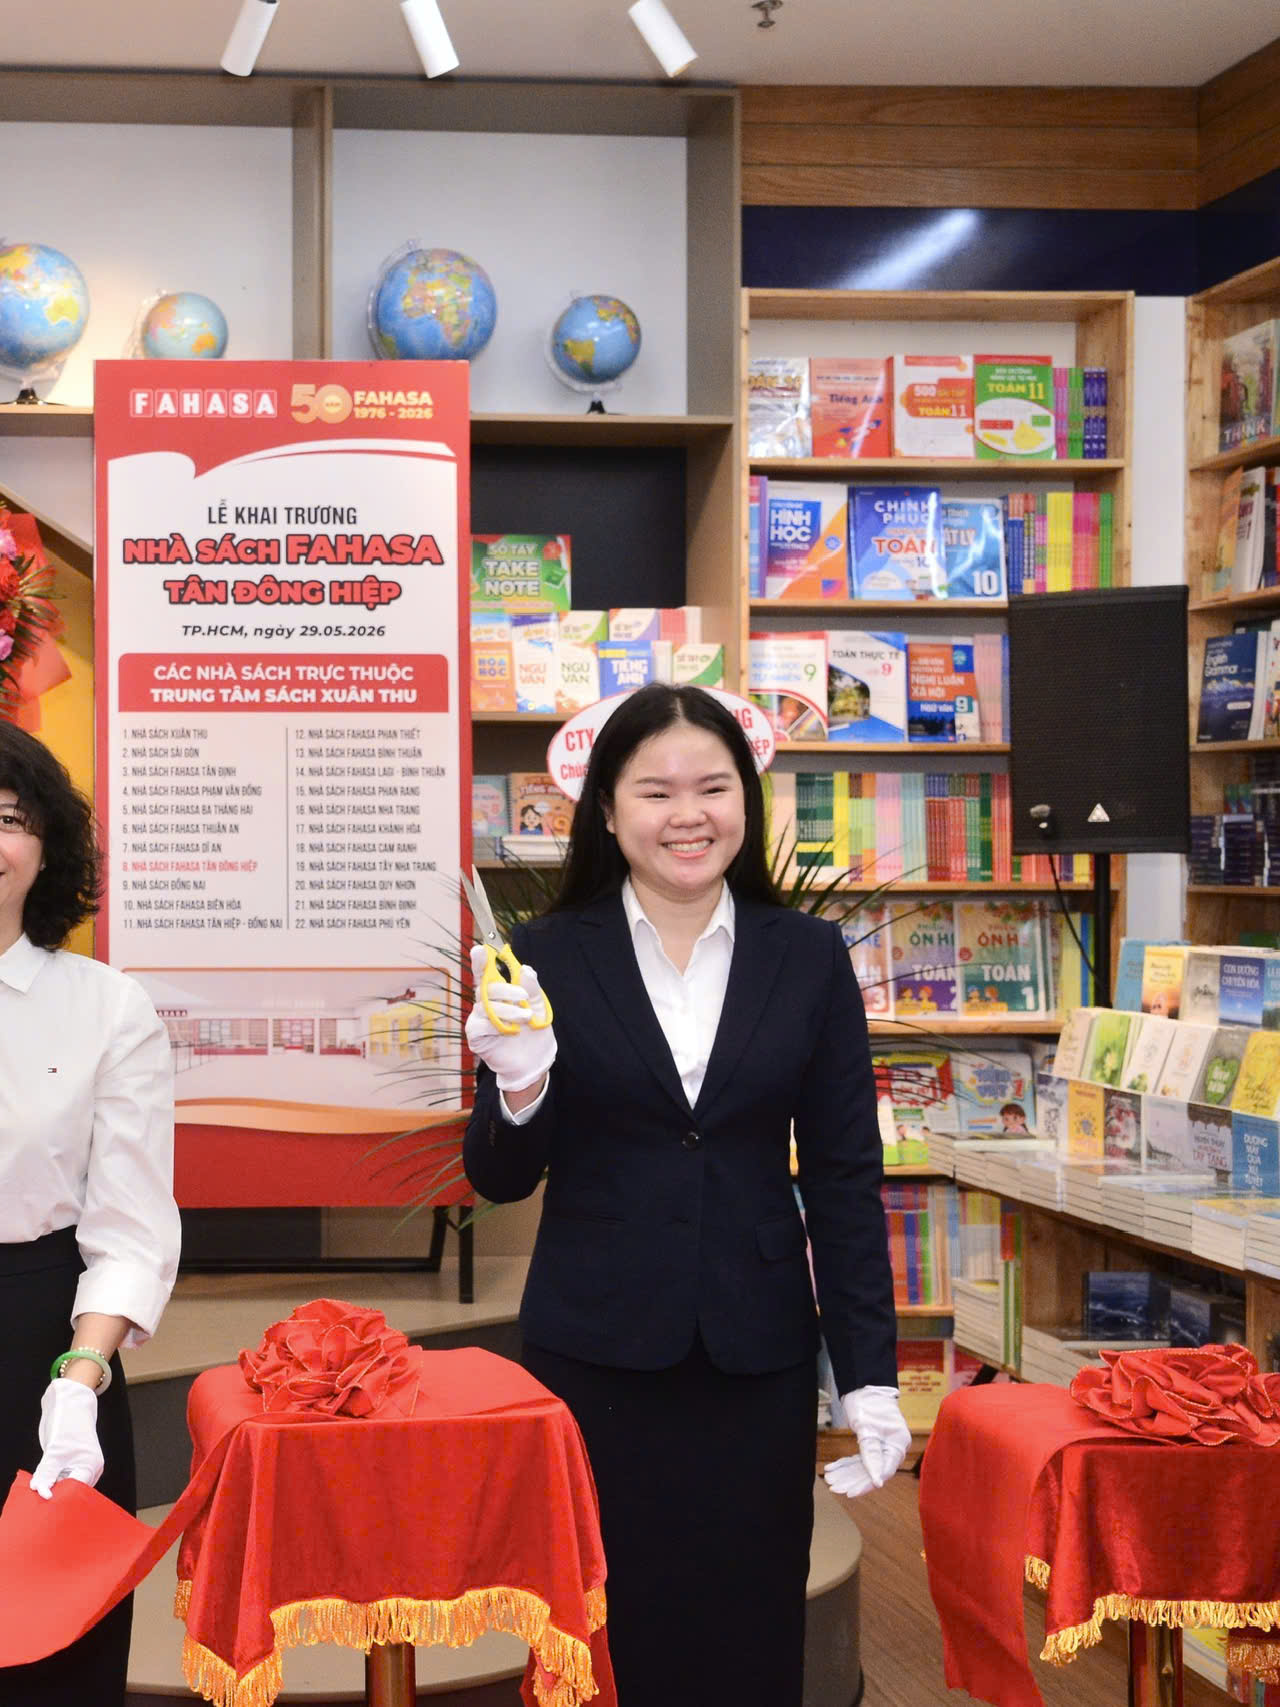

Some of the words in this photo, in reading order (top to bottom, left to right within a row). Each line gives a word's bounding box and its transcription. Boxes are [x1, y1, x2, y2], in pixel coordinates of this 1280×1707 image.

[354, 391, 433, 406] FAHASA
[1029, 383, 1045, 399] 11
[134, 391, 277, 416] FAHASA
[291, 384, 352, 424] 50
[355, 407, 387, 419] 1976
[398, 407, 433, 419] 2026
[208, 499, 228, 524] LỄ
[235, 506, 278, 525] KHAI
[284, 506, 358, 525] TRƯƠNG
[123, 533, 192, 564] NHÀ
[195, 533, 280, 565] SÁCH
[286, 534, 444, 565] FAHASA
[485, 561, 539, 577] TAKE
[163, 575, 227, 604] TÂN
[232, 574, 325, 605] ĐÔNG
[330, 575, 402, 611] HIỆP
[485, 580, 539, 597] NOTE
[973, 570, 998, 596] 10
[182, 625, 249, 638] TP.HCM,
[253, 625, 295, 639] ngày
[300, 625, 385, 638] 29.05.2026
[154, 662, 191, 681] CÁC
[196, 662, 238, 681] NHÀ
[241, 663, 292, 682] SÁCH
[295, 664, 348, 684] TRỰC
[351, 664, 414, 684] THUỘC
[804, 664, 816, 681] 9
[150, 688, 216, 703] TRUNG
[219, 685, 261, 703] TÂM
[265, 685, 317, 703] SÁCH
[320, 686, 376, 704] XUÂN
[378, 689, 418, 704] THU
[956, 697, 968, 713] 9
[565, 728, 594, 751] CTY
[871, 987, 885, 1010] 3
[1022, 986, 1035, 1010] 1
